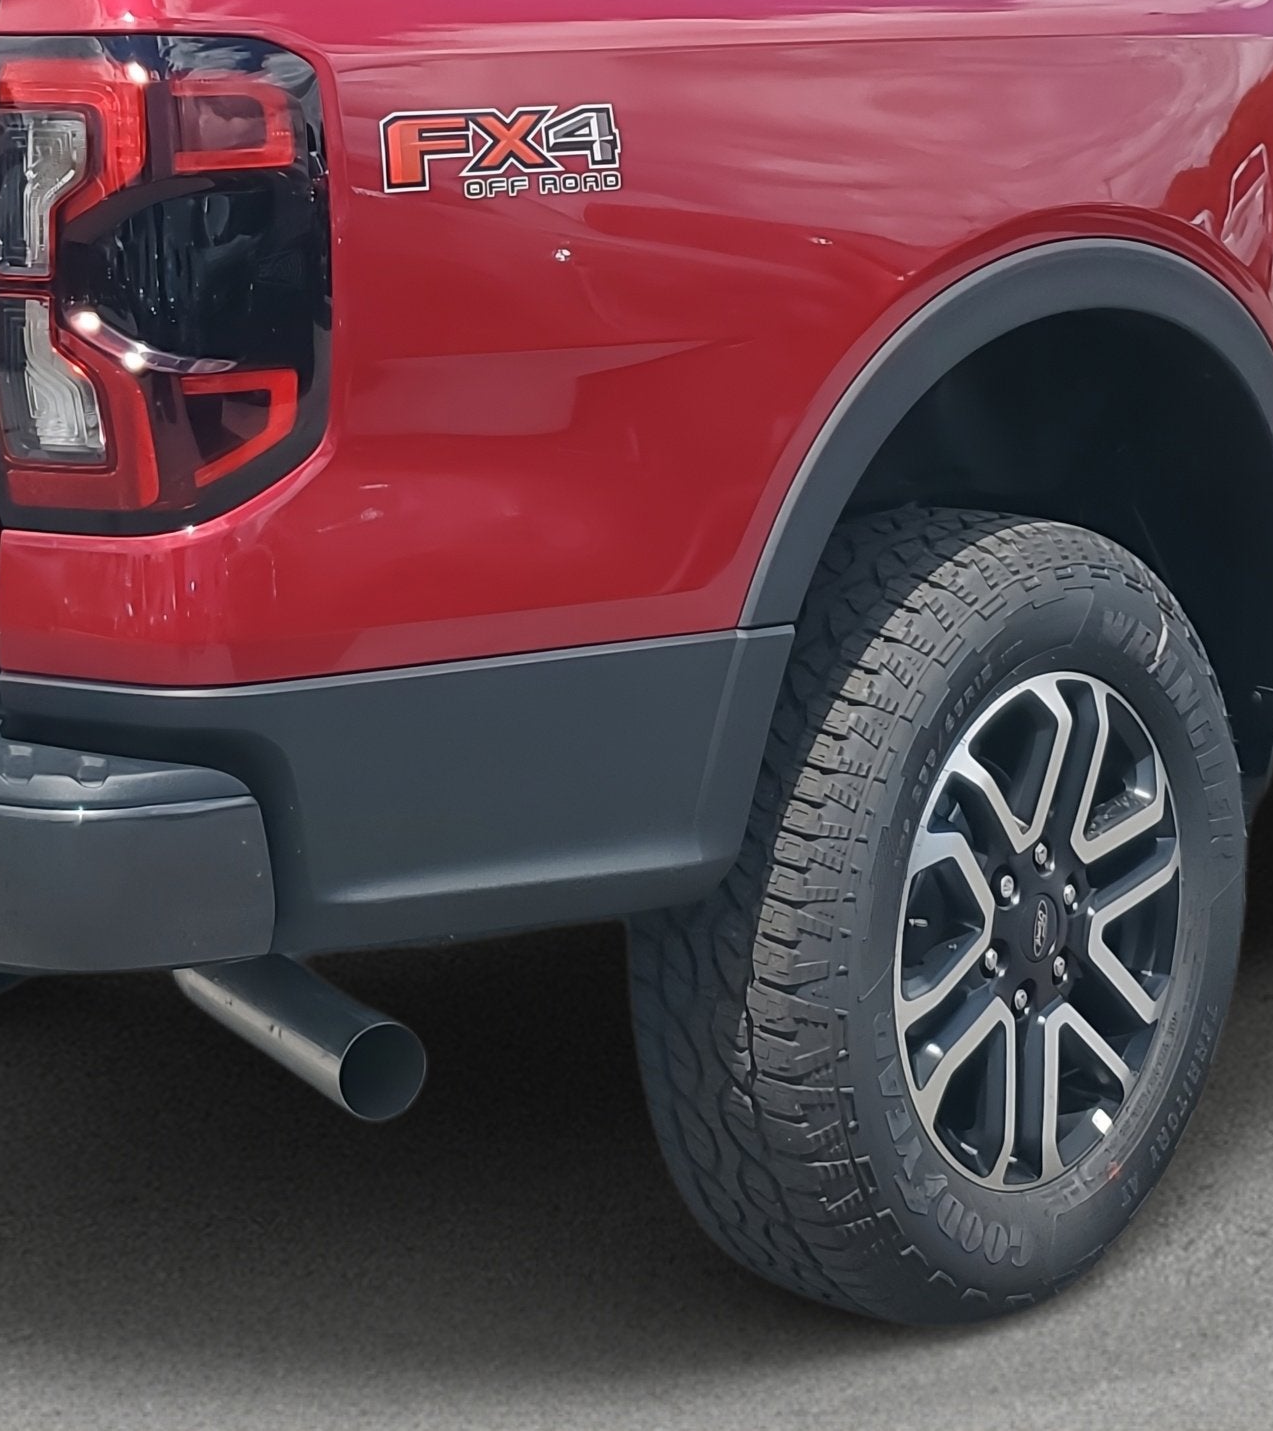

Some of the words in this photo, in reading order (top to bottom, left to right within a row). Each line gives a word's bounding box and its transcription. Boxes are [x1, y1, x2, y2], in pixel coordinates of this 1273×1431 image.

[379, 104, 621, 193] FX4
[464, 176, 528, 199] OFF
[539, 171, 622, 195] ROAD
